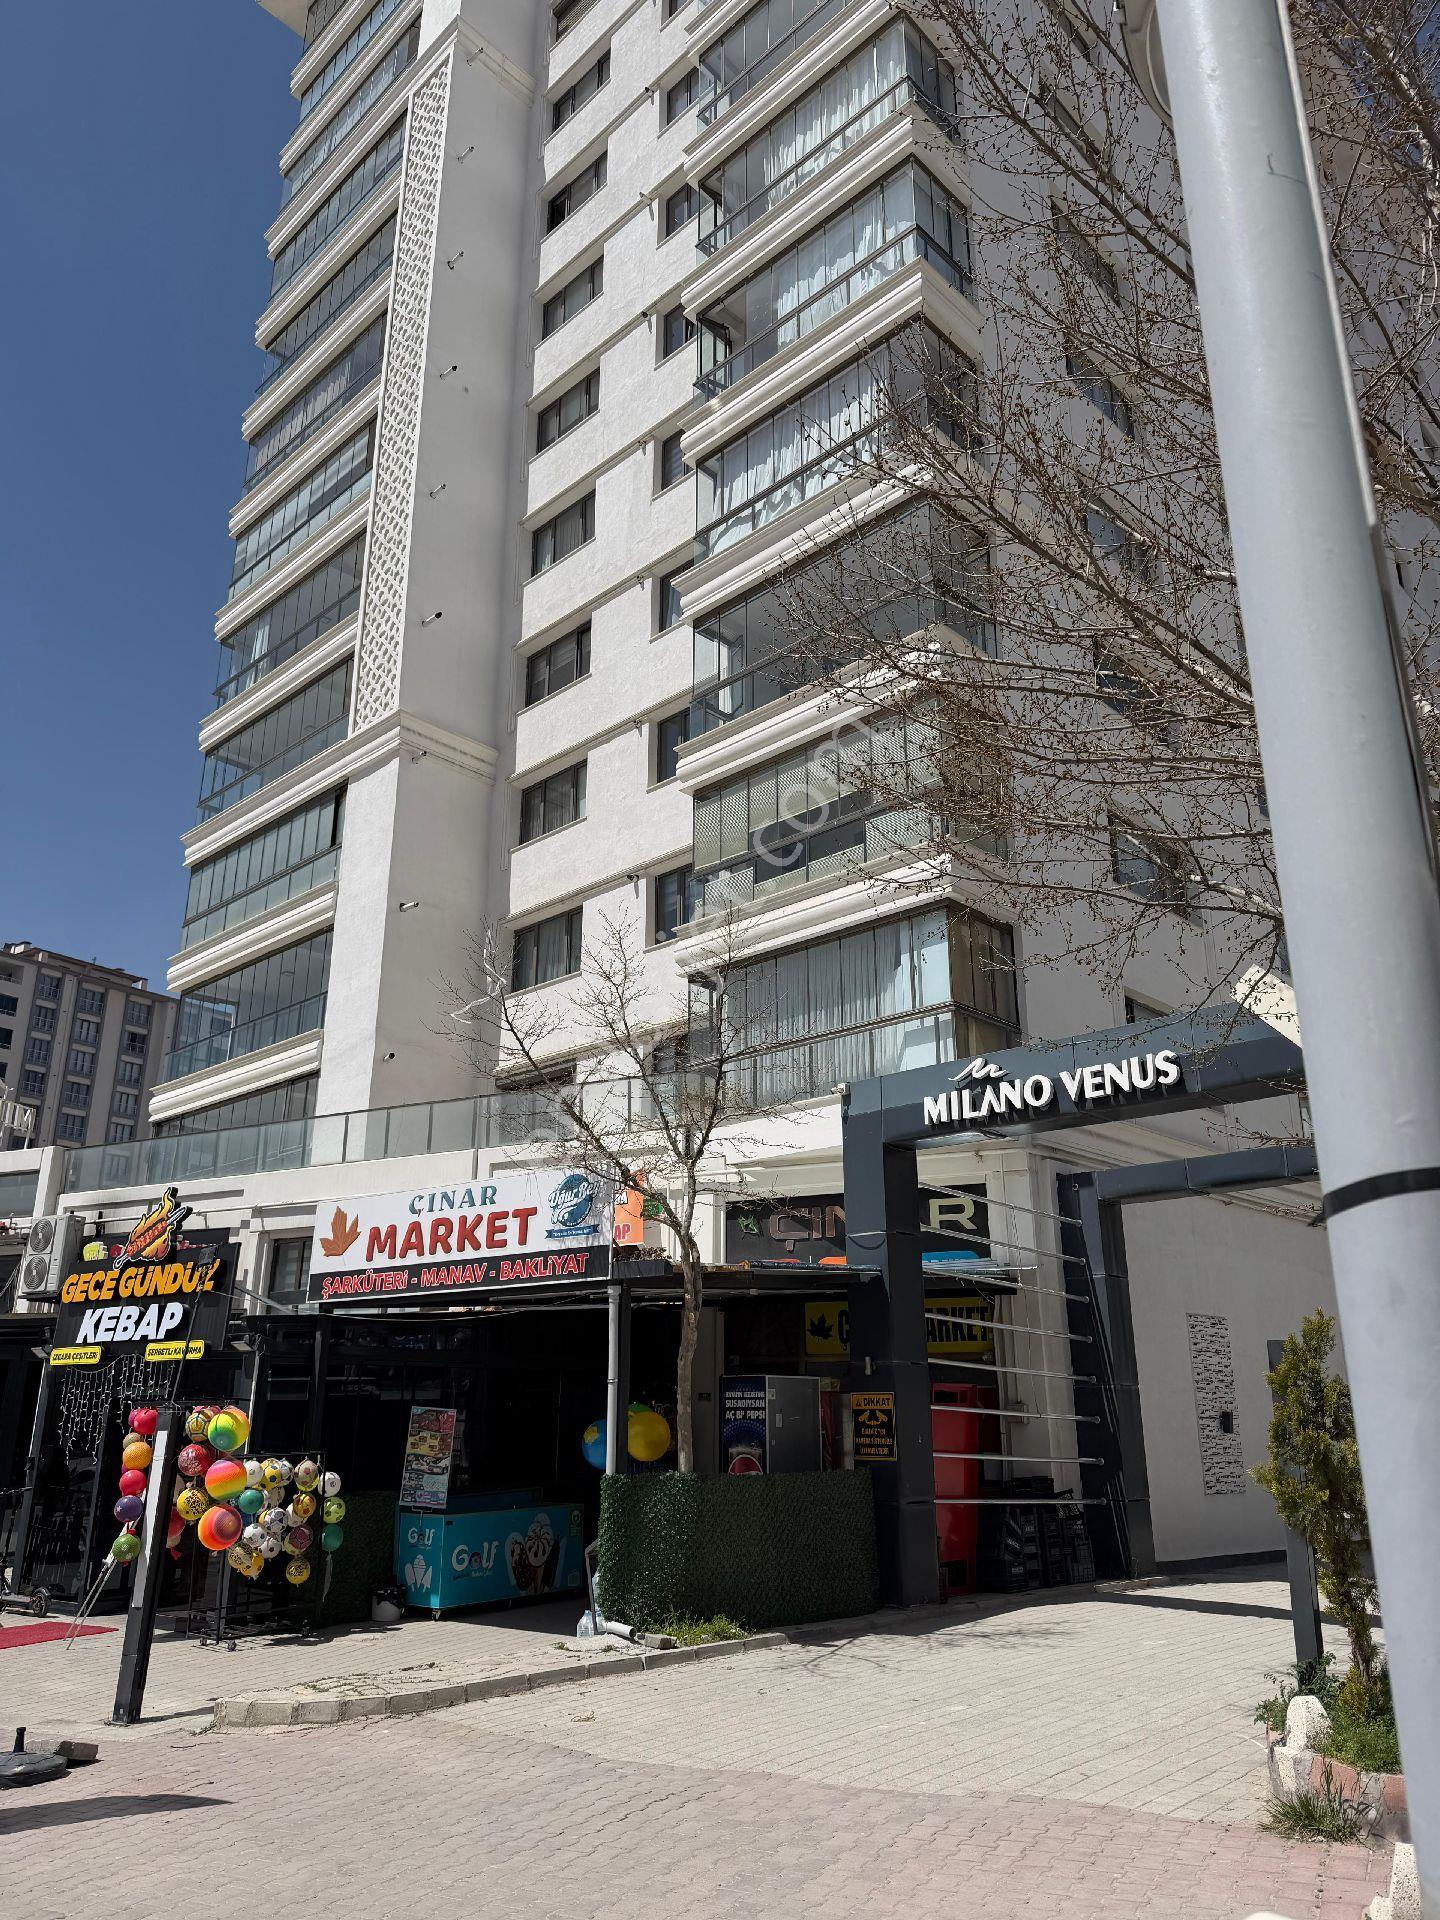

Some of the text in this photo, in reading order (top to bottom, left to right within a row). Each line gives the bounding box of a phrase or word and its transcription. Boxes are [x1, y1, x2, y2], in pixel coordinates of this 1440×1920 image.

[924, 1050, 1181, 1125] MILANO VENUS
[409, 1185, 498, 1217] ÇINAR
[365, 1206, 538, 1262] MARKET
[61, 1270, 120, 1304] GECE
[421, 1263, 487, 1287] MANAV
[76, 1302, 184, 1344] KEBAP
[451, 1540, 500, 1572] Golf
